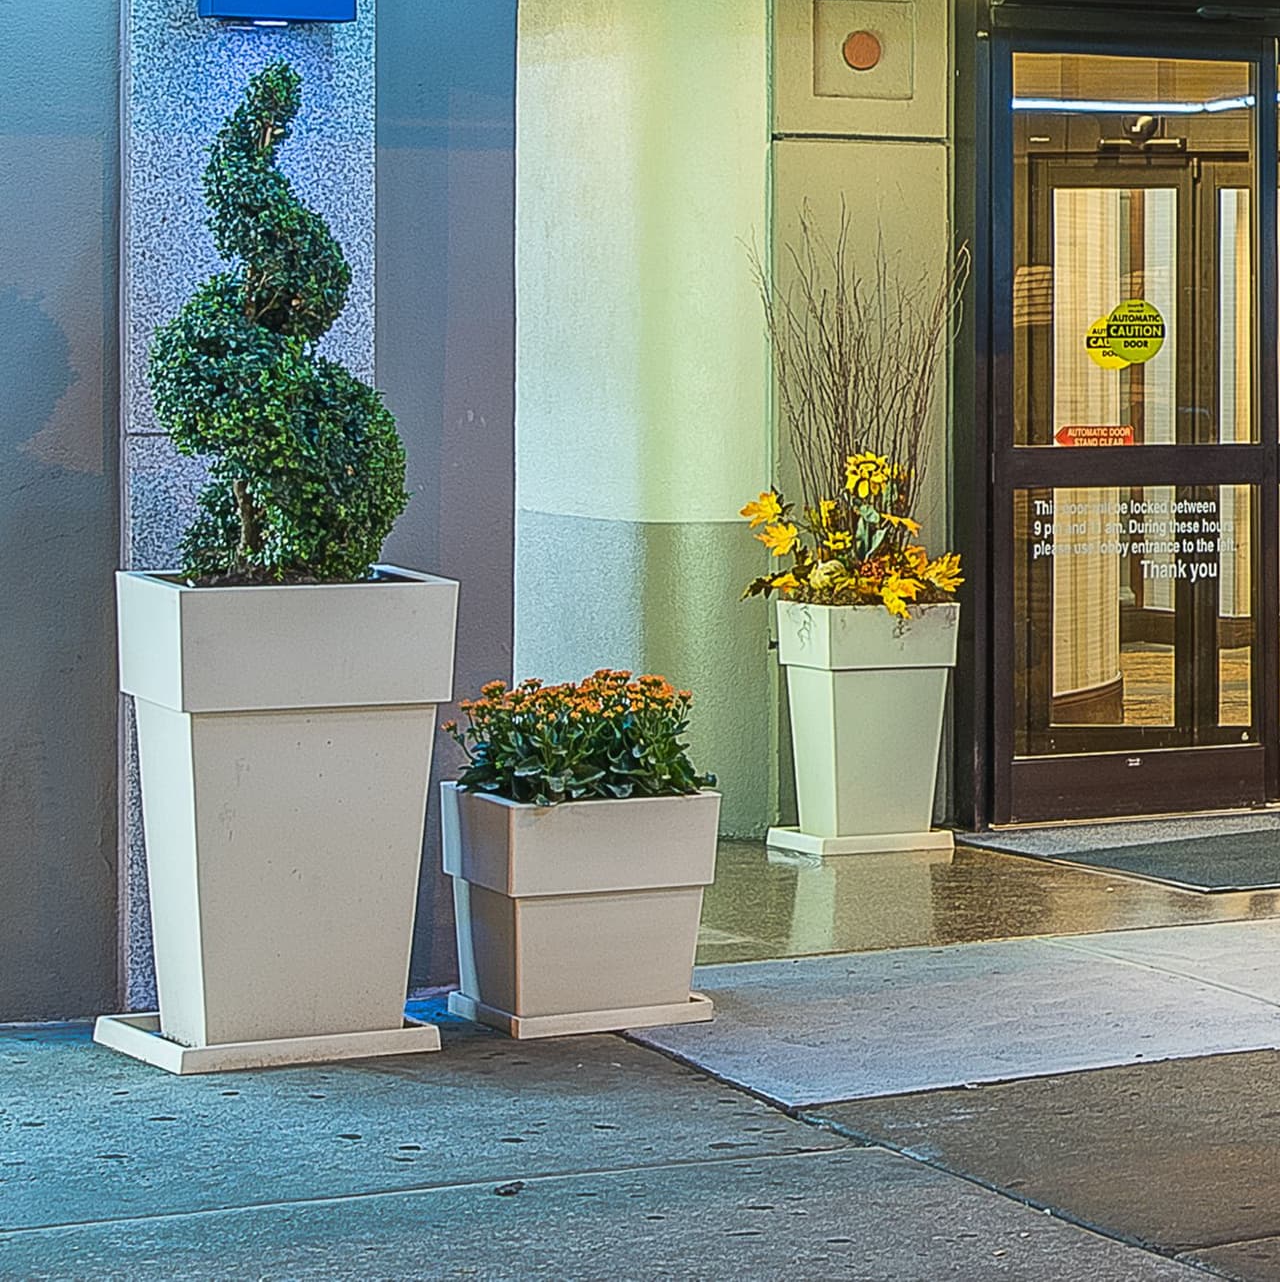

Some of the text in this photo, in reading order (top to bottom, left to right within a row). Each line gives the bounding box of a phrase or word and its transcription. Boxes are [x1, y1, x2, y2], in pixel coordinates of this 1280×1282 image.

[1112, 314, 1160, 322] AUTOMATIC
[1109, 325, 1162, 336] CAUTION
[1123, 340, 1148, 348] DOOR
[1067, 426, 1131, 437] AUTOMATIC DOOR
[1033, 500, 1057, 515] Thi
[1130, 499, 1167, 514] locked
[1170, 499, 1216, 514] between
[1033, 520, 1042, 535] 9
[1129, 519, 1166, 536] During
[1169, 518, 1200, 533] these
[1131, 539, 1180, 554] entrance
[1182, 538, 1194, 553] to
[1196, 538, 1215, 553] the
[1140, 559, 1217, 582] Thank you
